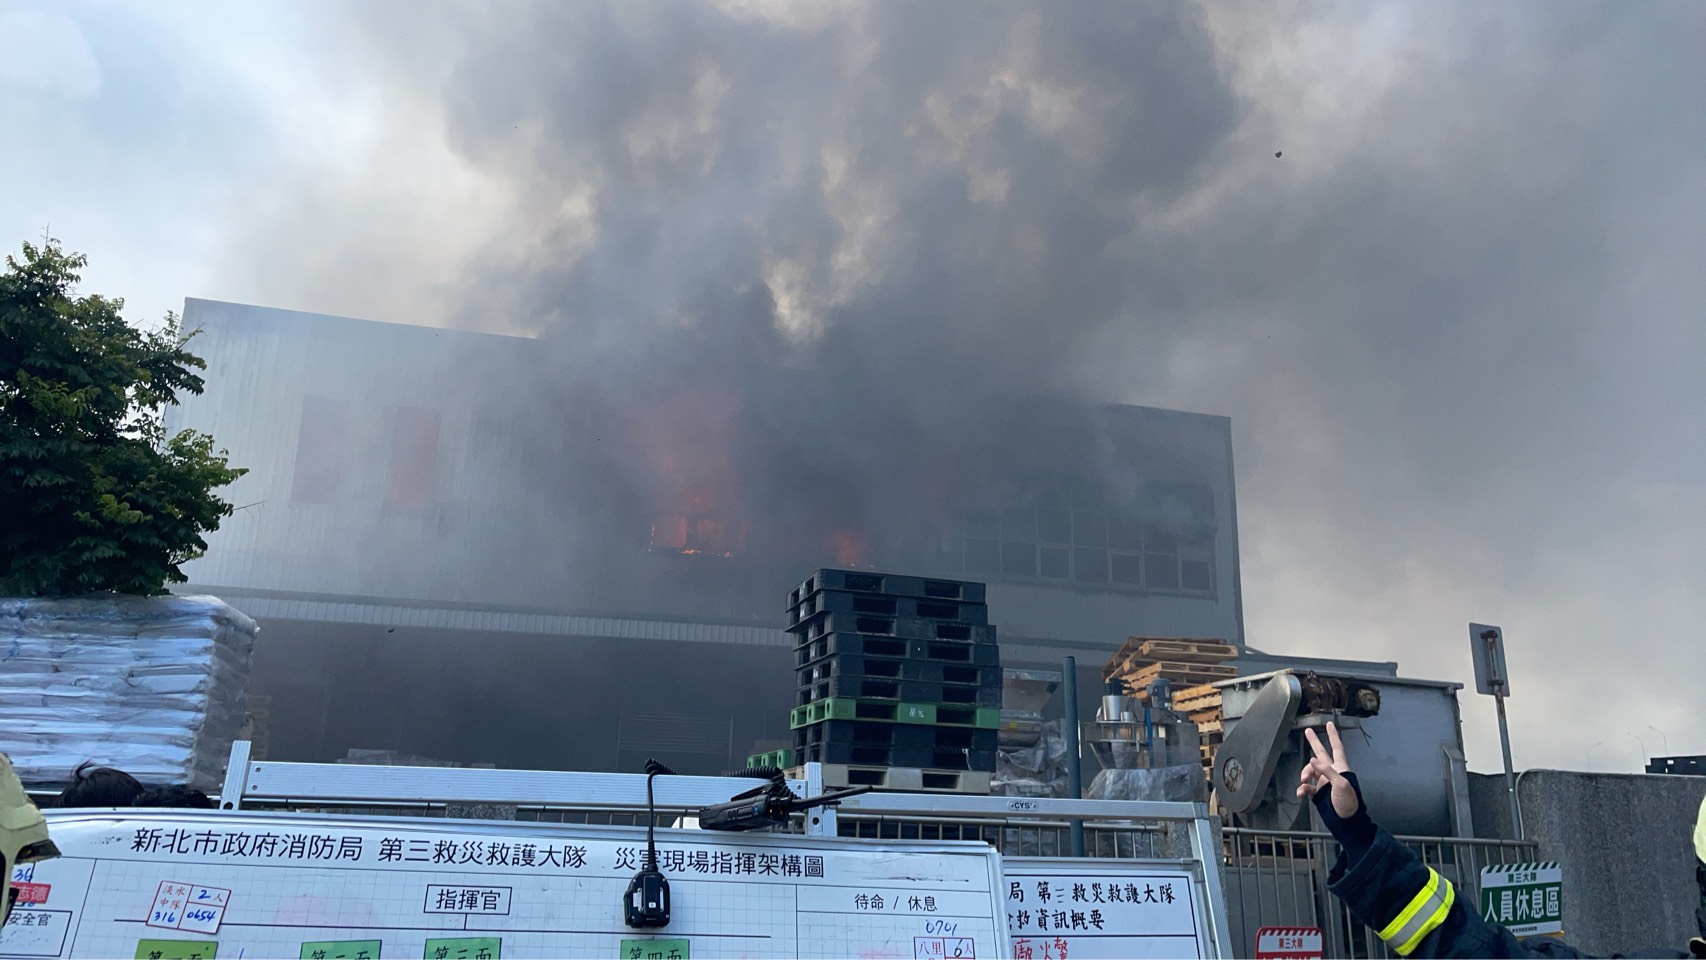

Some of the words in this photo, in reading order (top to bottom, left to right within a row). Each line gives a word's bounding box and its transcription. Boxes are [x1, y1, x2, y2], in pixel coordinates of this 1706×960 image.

[130, 827, 363, 862] 新北市政府消防局
[377, 837, 587, 869] 第三救災救護大隊
[612, 846, 825, 878] 災害現場指揮架構圖
[1507, 872, 1537, 883] 第三大隊
[435, 889, 501, 911] 指揮官
[1008, 881, 1025, 903] 局
[1037, 881, 1176, 904] 第三救災救護大隊
[854, 894, 885, 911] 待命
[907, 895, 938, 911] 休息
[1484, 887, 1560, 922] 人員休息區
[8, 912, 52, 927] 安全官
[154, 911, 175, 923] 316
[186, 909, 216, 922] 0654
[1008, 910, 1105, 931] 救資訊概要
[919, 941, 943, 956] 八里
